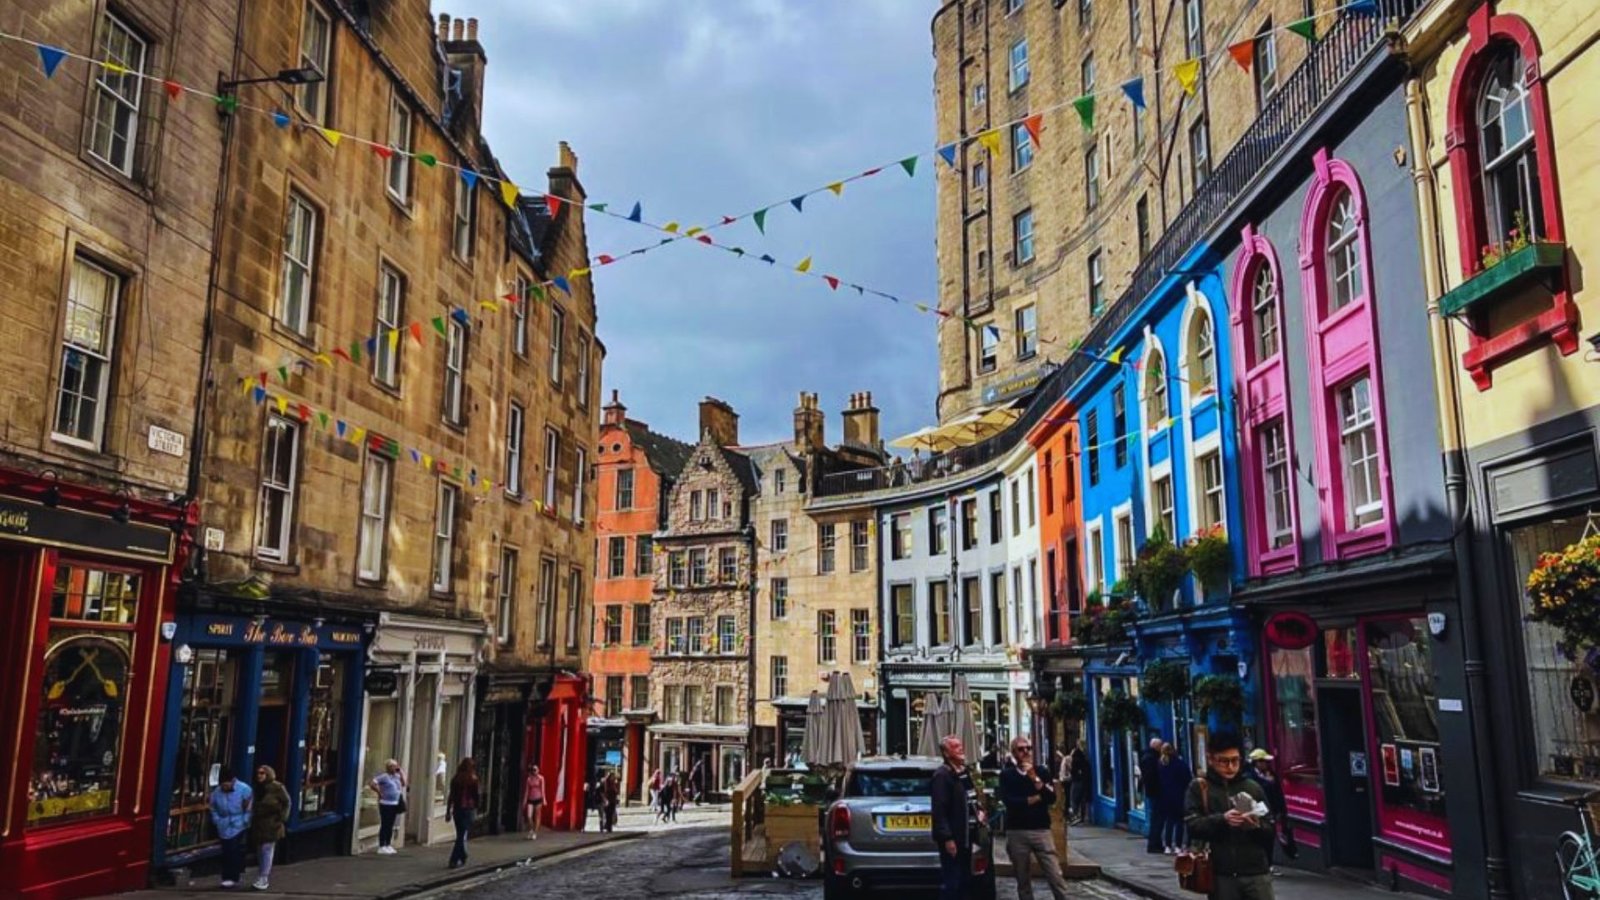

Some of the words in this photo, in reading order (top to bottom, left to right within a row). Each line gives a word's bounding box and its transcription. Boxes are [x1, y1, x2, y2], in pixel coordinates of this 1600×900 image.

[152, 428, 182, 445] VICTORIA
[153, 439, 179, 453] STREET
[207, 623, 234, 636] SPIRIT
[243, 620, 267, 643] The
[298, 624, 319, 646] Bar
